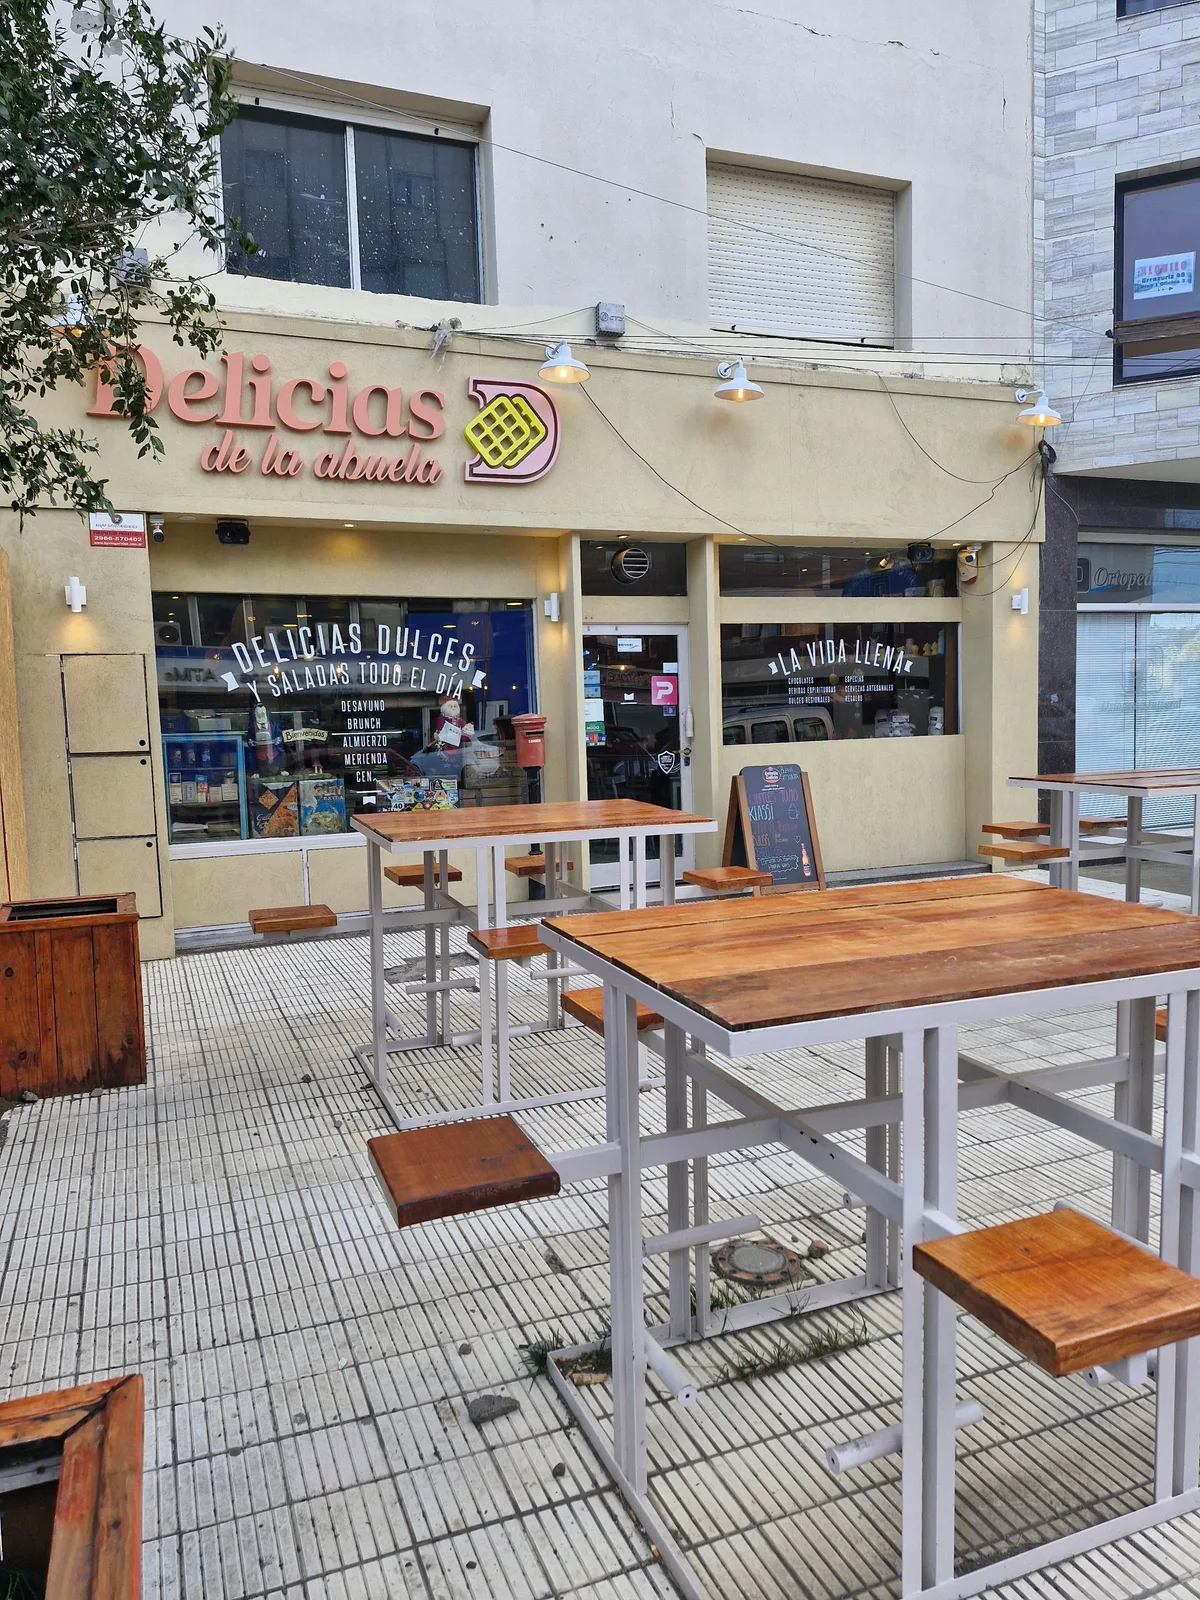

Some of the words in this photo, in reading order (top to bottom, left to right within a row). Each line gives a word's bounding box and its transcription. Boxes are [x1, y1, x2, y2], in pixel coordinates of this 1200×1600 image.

[86, 341, 446, 441] Delicias
[200, 429, 253, 475] de
[261, 432, 303, 478] la
[313, 437, 444, 485] abuela
[231, 623, 362, 674] DELICIAS
[377, 624, 475, 672] DULCES
[777, 647, 801, 677] LA
[806, 639, 847, 667] VIDA
[855, 639, 905, 674] LLENA
[247, 682, 262, 702] Y
[267, 662, 349, 697] SALADAS
[359, 662, 401, 686] TODO
[410, 667, 427, 690] EL
[436, 672, 463, 700] DÍA
[788, 676, 814, 685] CHOCOLATES
[844, 675, 864, 683] ESPECIAS
[844, 685, 865, 693] CERVEZAS
[866, 684, 894, 692] ARTESANALES
[844, 694, 863, 702] REGALOS
[341, 700, 385, 712] DESAYUNO
[347, 718, 381, 730] BRUNCH
[343, 735, 388, 748] ALMUERZO
[344, 753, 388, 765] MERIENDA
[356, 771, 377, 783] CEN
